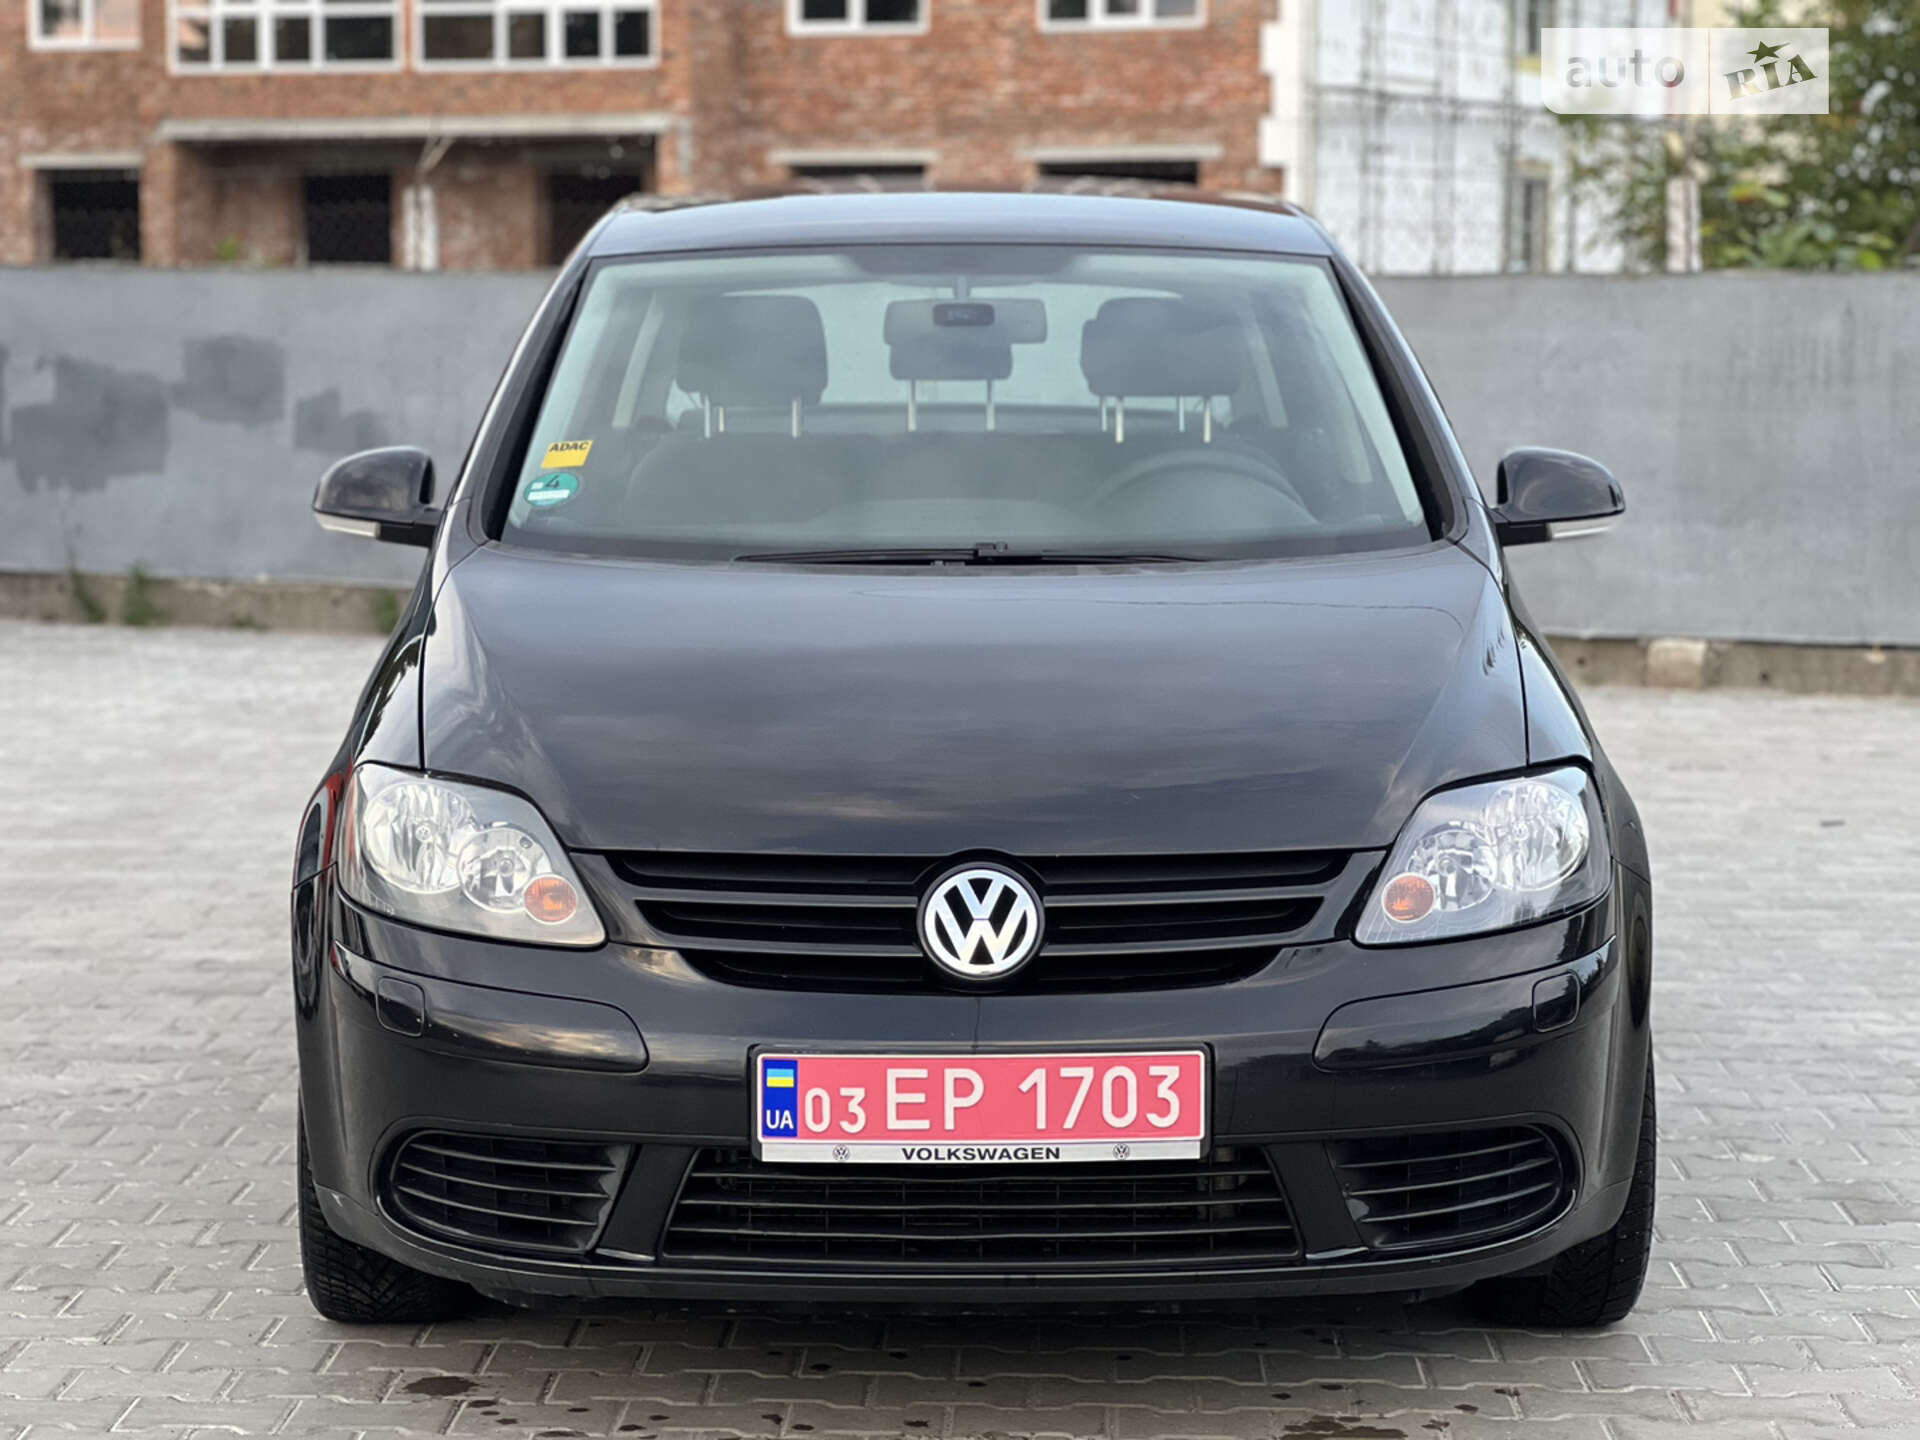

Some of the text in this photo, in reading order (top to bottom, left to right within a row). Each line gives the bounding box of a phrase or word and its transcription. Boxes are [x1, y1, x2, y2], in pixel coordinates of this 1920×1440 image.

[549, 441, 589, 452] ADAC
[545, 475, 561, 489] 4
[804, 1065, 1181, 1134] 03 EP 1703
[766, 1109, 794, 1130] UA
[901, 1146, 1061, 1161] VOLKSWAGEN
